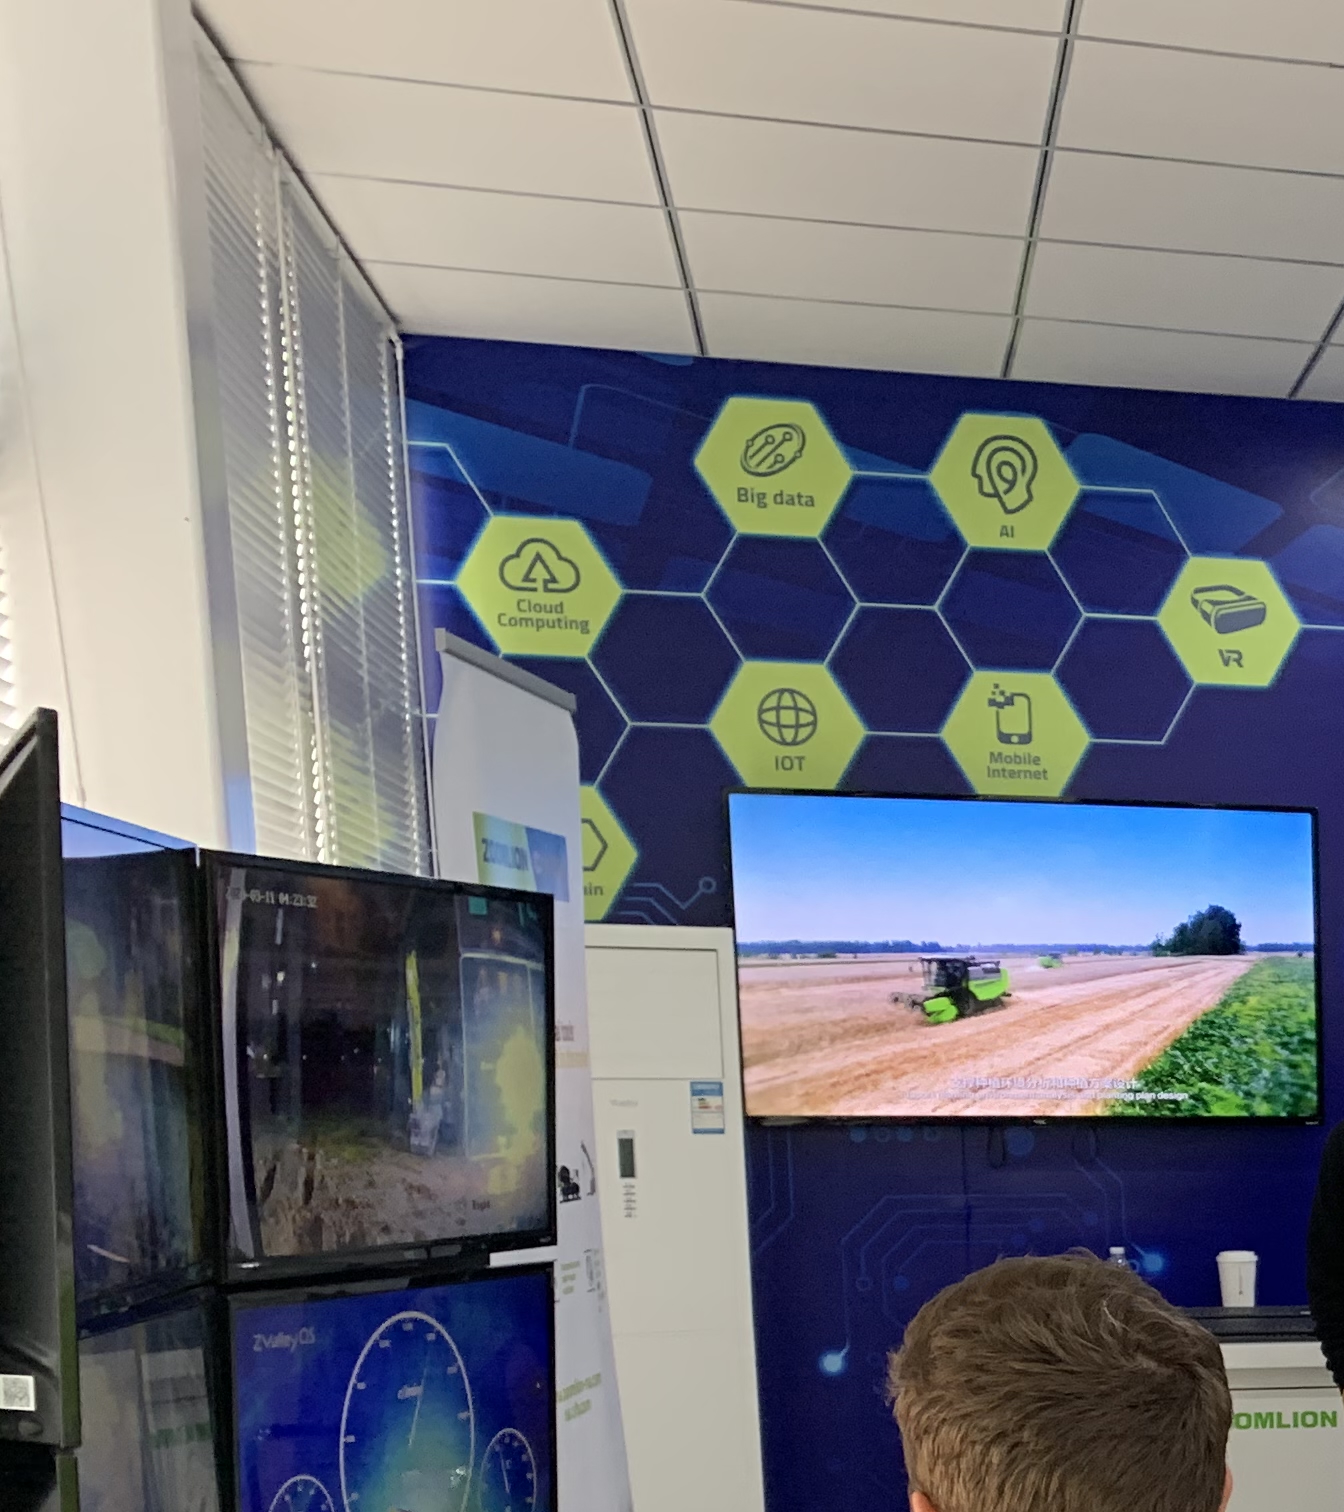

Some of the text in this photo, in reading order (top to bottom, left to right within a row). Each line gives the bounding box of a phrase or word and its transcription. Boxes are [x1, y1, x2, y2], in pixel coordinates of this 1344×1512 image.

[736, 486, 816, 510] Big data
[999, 524, 1016, 539] AI
[516, 598, 565, 615] Cloud
[497, 613, 591, 635] Computing
[1217, 648, 1245, 669] VR
[774, 754, 806, 773] IOT
[989, 751, 1042, 767] Mobile
[986, 764, 1049, 781] Internet
[1135, 1091, 1156, 1103] plan
[1157, 1090, 1189, 1101] design
[1231, 1410, 1338, 1430] OMLION
